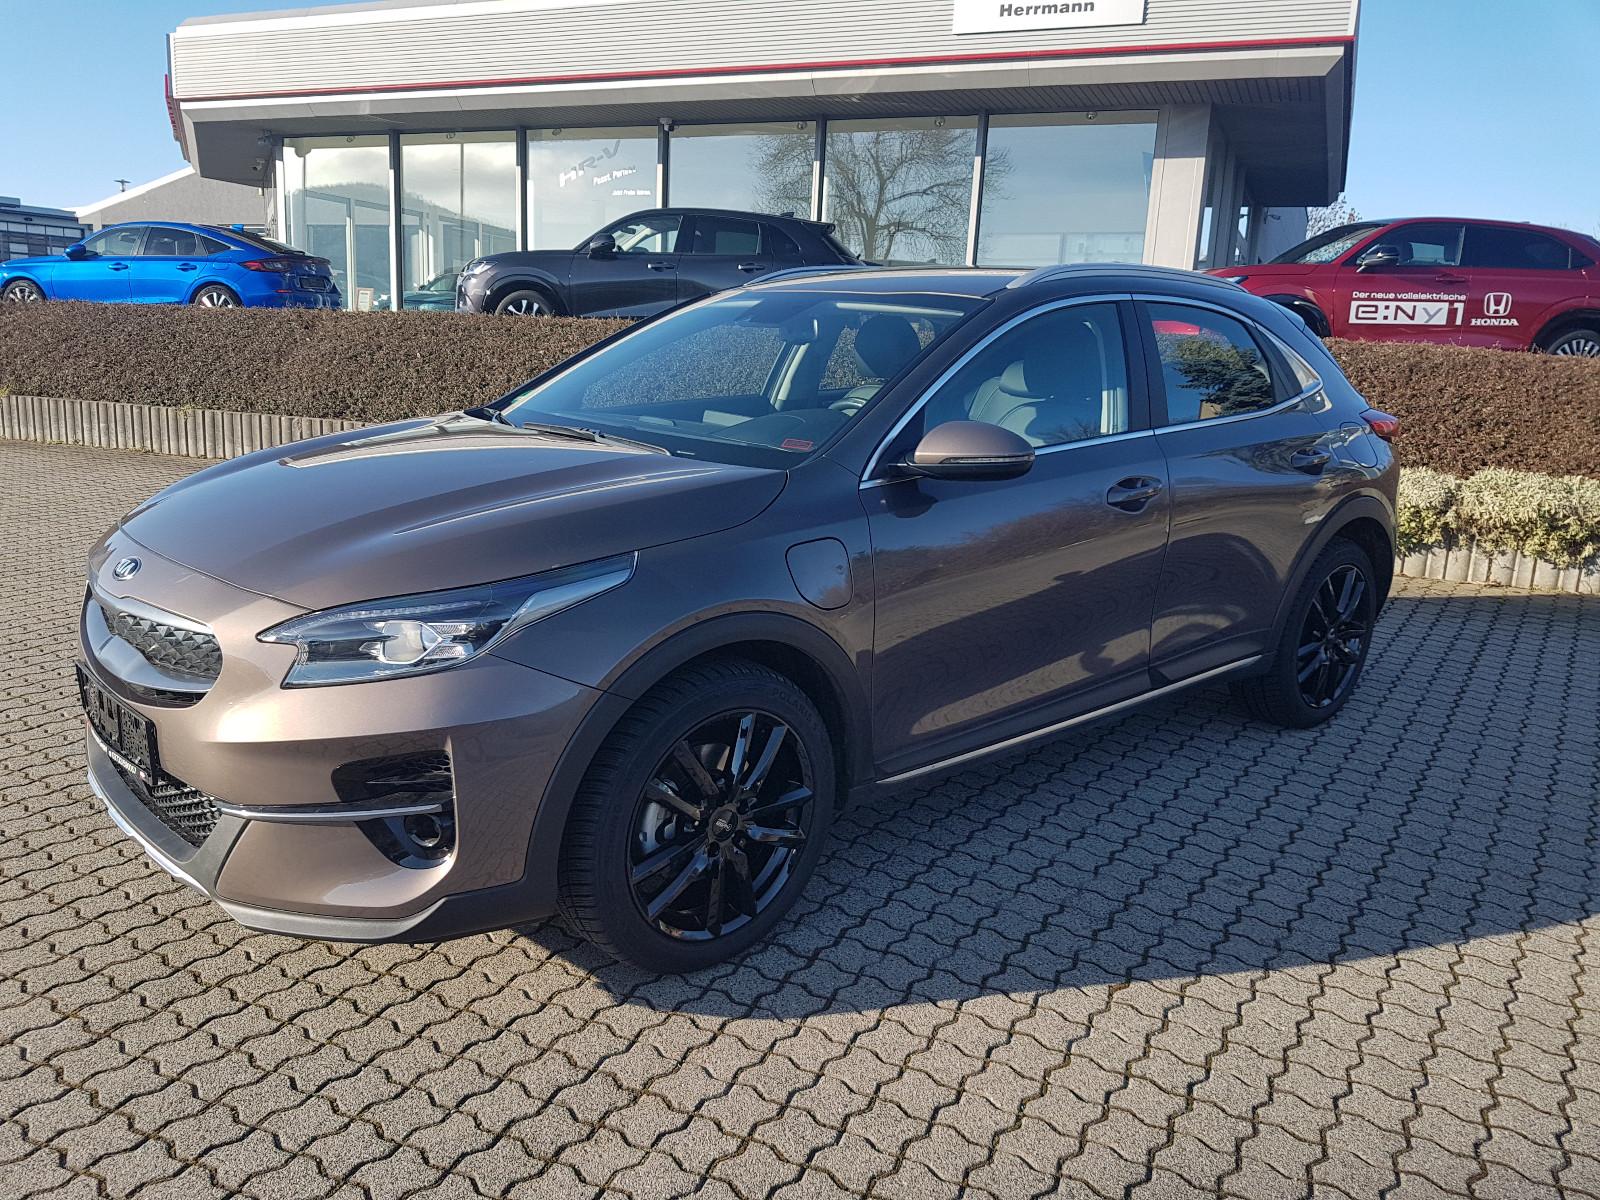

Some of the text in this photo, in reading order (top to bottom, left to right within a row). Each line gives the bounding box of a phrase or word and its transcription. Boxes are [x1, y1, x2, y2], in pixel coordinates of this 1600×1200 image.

[999, 1, 1095, 17] Herrmann
[1352, 291, 1370, 299] Der
[1396, 292, 1467, 301] vollelektrische
[1470, 318, 1519, 327] HONDA
